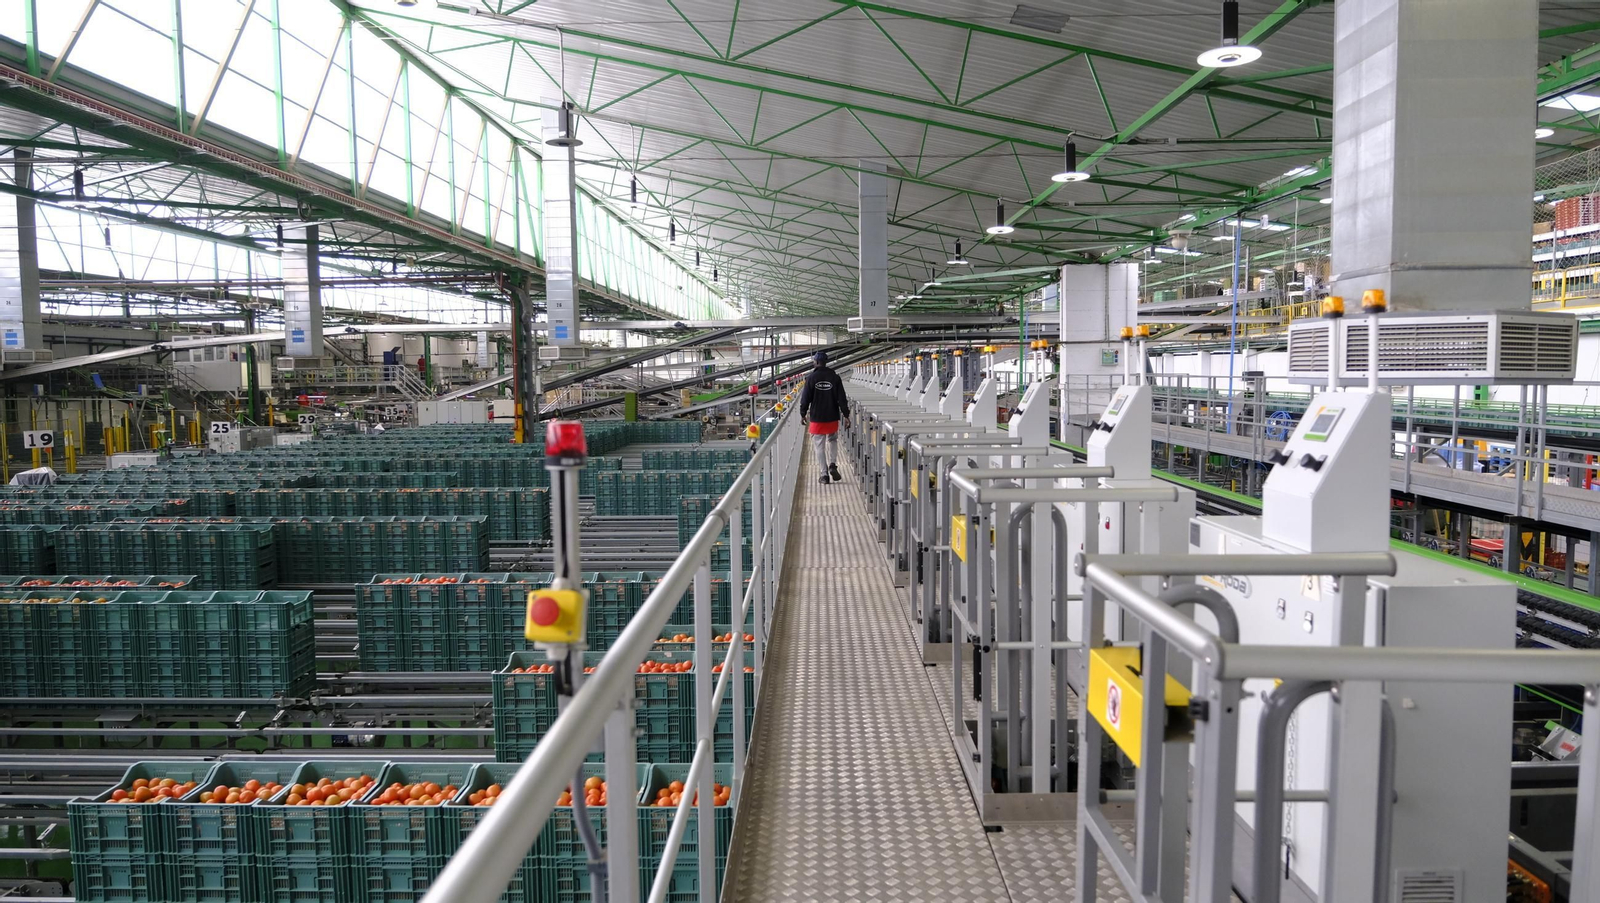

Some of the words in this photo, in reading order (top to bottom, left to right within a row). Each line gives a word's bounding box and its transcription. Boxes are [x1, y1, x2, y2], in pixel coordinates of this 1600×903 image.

[386, 407, 398, 416] 35
[299, 415, 315, 424] 29
[212, 423, 230, 434] 25
[28, 432, 53, 447] 19
